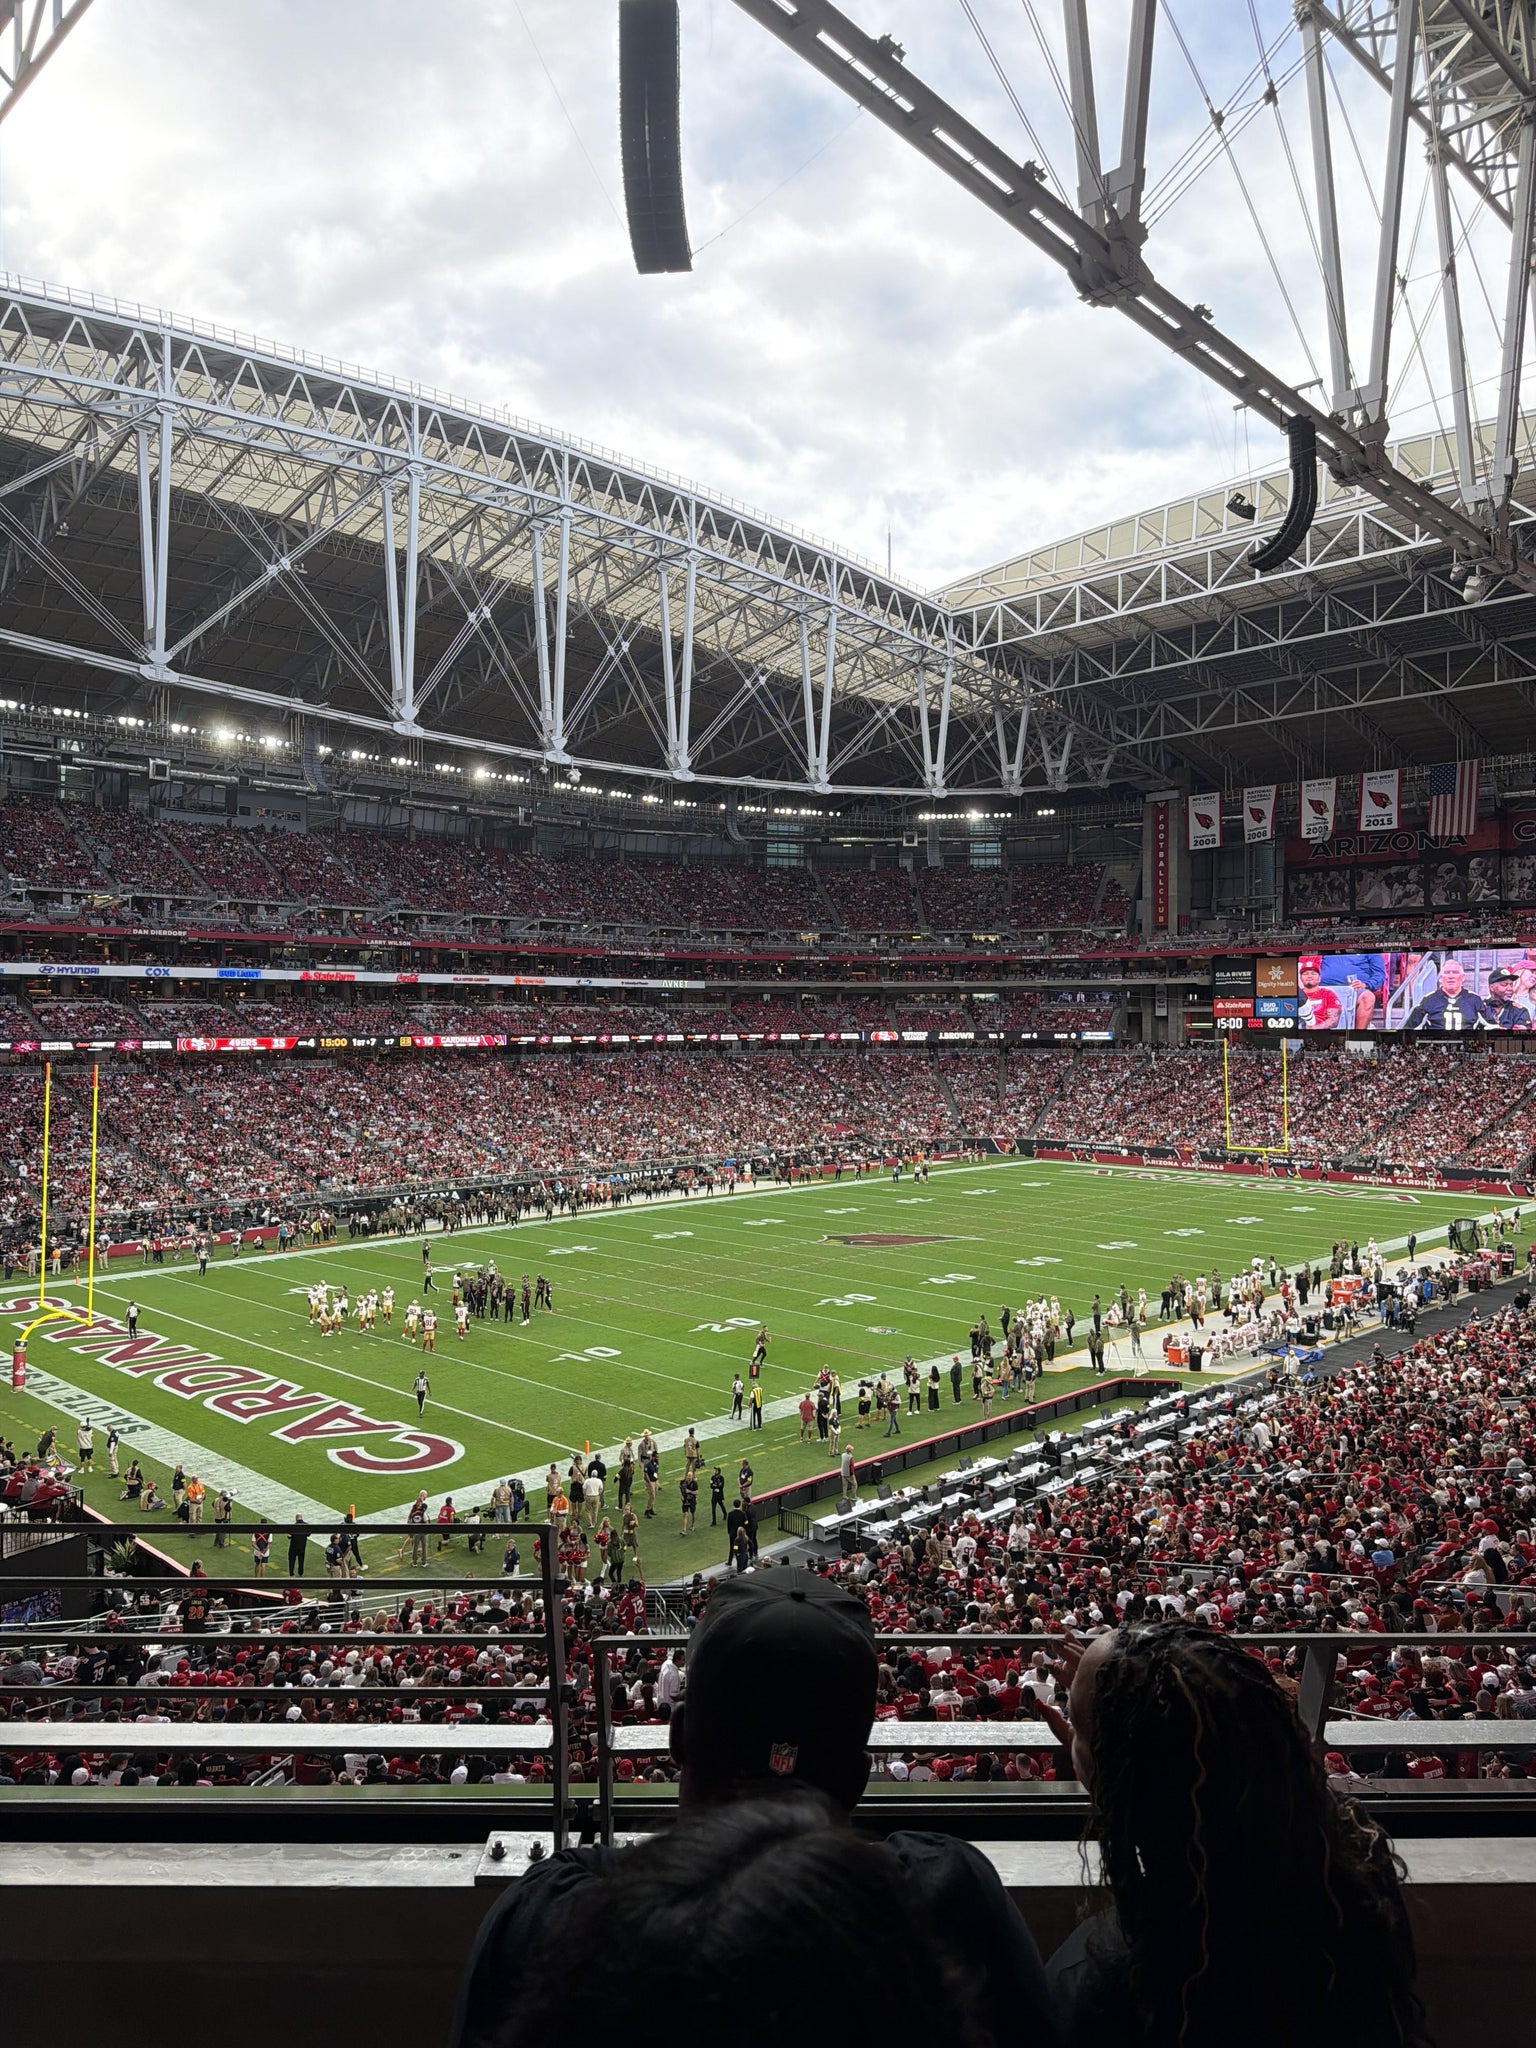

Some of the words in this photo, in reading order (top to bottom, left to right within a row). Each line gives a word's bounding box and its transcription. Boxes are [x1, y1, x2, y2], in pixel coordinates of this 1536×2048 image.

[1365, 818, 1393, 827] 2015
[1247, 830, 1267, 840] 2008
[1306, 825, 1329, 835] 2009
[1193, 838, 1216, 846] 2008
[1309, 830, 1468, 860] ARIZONA
[145, 968, 170, 976] COX
[1217, 1018, 1242, 1029] 15:00
[1268, 1018, 1294, 1028] 0:20
[228, 1038, 258, 1046] 49ERS
[272, 1039, 286, 1048] 35
[307, 1038, 316, 1048] 4
[320, 1038, 348, 1047] 15:00
[423, 1038, 434, 1046] 10
[440, 1036, 480, 1044] CARDINALS
[1061, 1169, 1420, 1203] ARIZONA
[1013, 1256, 1063, 1267] 50
[927, 1273, 977, 1286] 40
[820, 1293, 878, 1307] 30
[697, 1317, 761, 1333] 20
[562, 1346, 622, 1363] 10
[0, 1296, 466, 1475] CARDINALS
[26, 1381, 70, 1396] TO
[51, 1394, 151, 1435] SALUTE
[140, 1596, 150, 1606] 55
[632, 1601, 644, 1614] 12
[92, 1666, 105, 1681] 39
[772, 1754, 795, 1771] NFL
